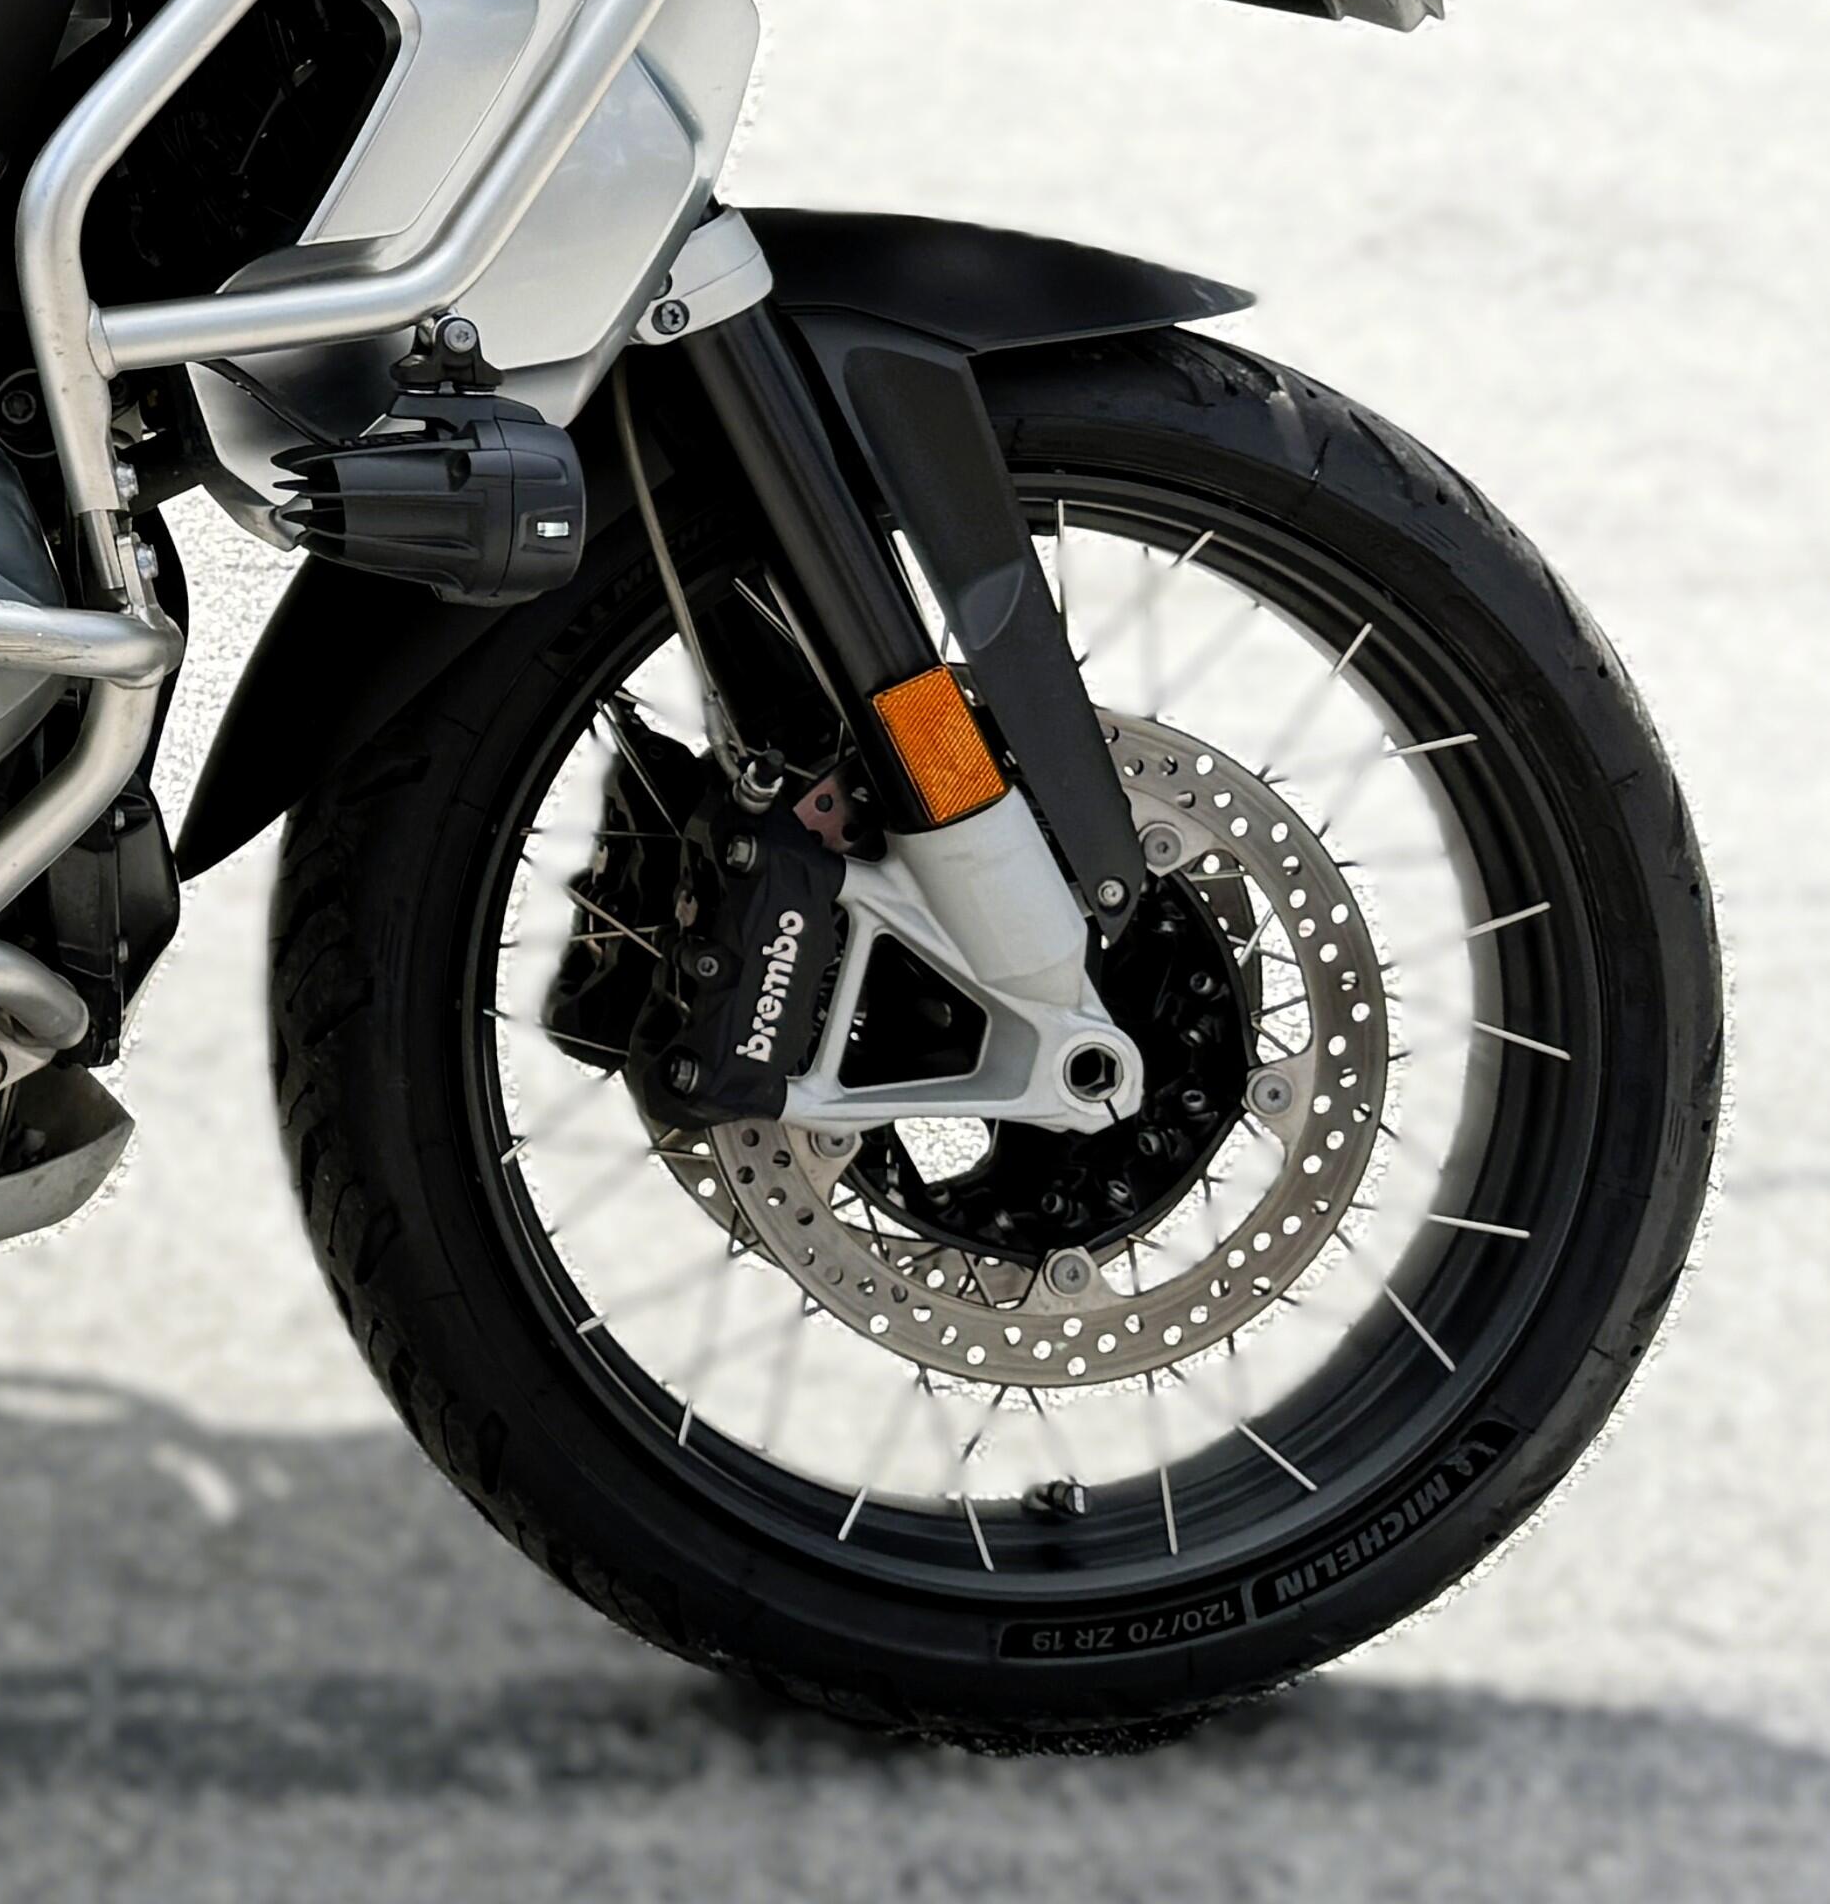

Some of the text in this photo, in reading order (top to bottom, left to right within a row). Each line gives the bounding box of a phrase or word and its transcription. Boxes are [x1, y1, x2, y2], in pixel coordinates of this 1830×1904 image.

[735, 910, 804, 1063] brembo
[1274, 1471, 1452, 1603] MICHELIN
[1031, 1599, 1235, 1652] 120/70 ZR 19
